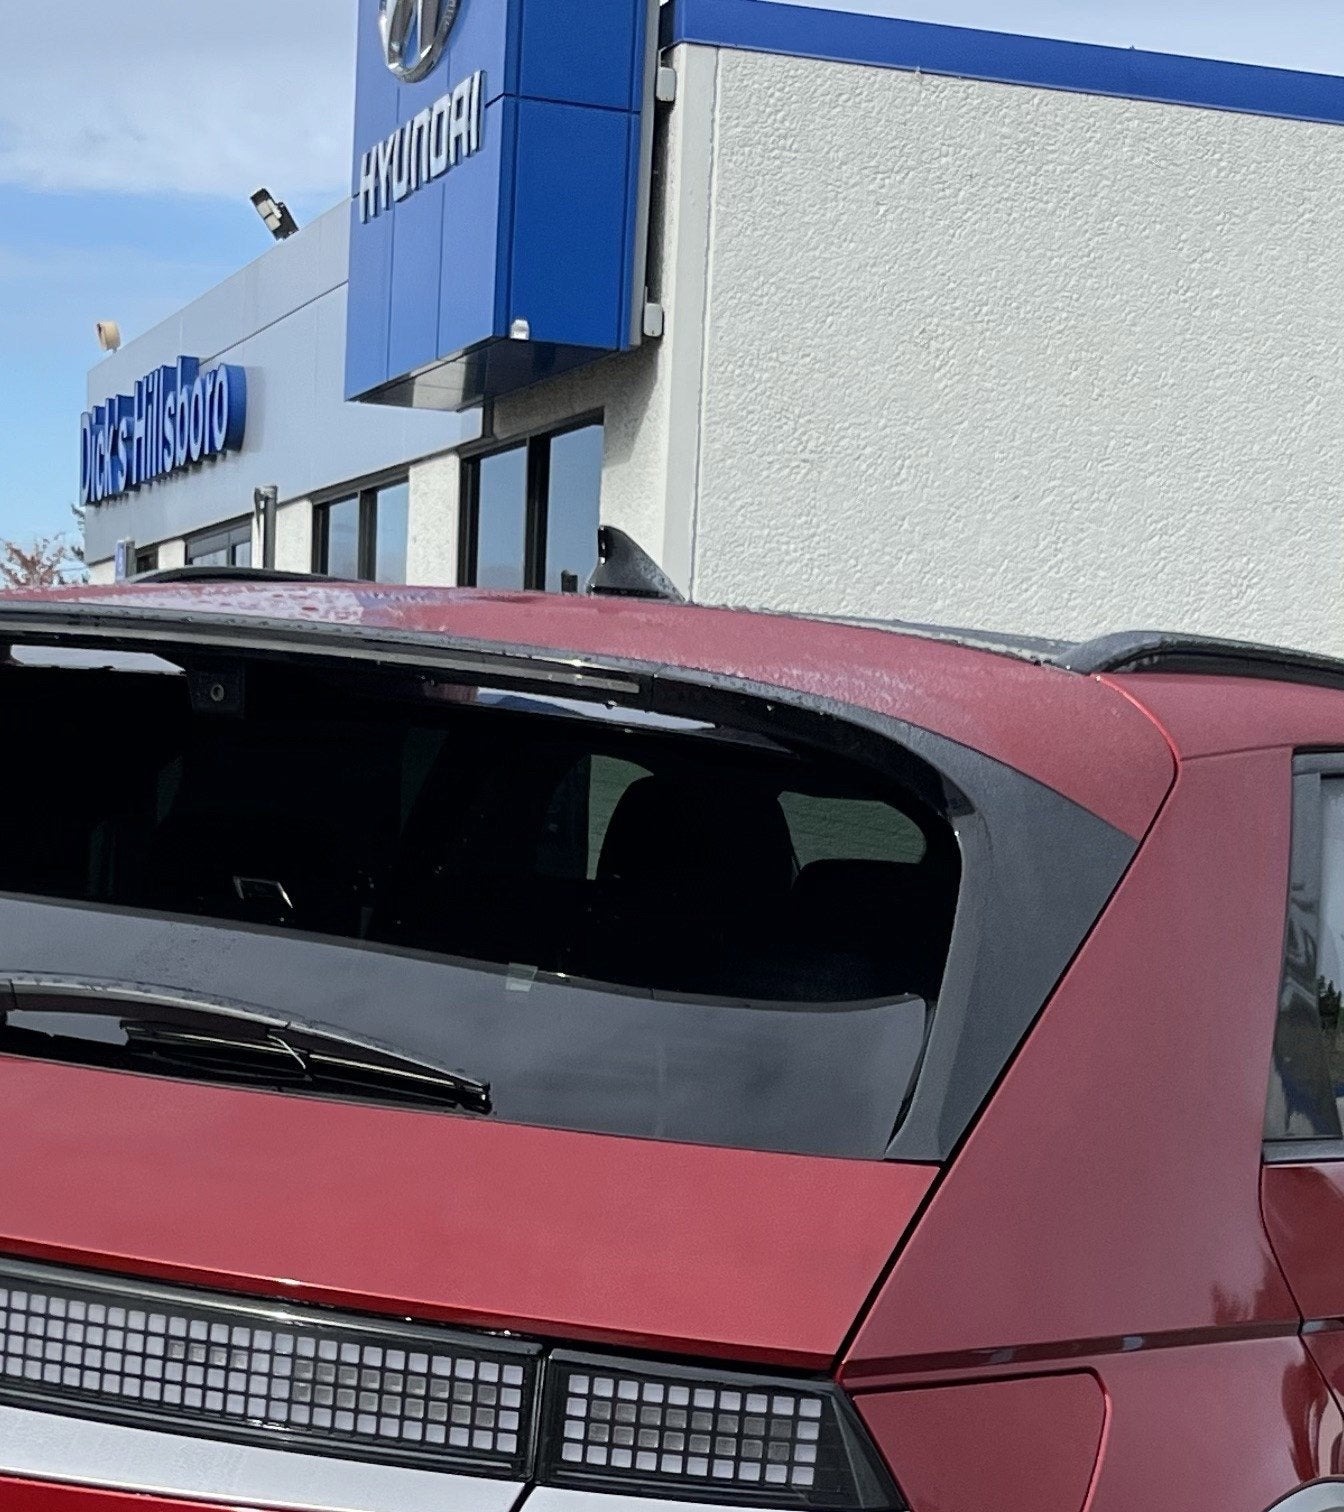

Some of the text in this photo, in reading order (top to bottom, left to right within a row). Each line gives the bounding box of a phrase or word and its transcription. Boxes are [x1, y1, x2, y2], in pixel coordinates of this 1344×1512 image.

[360, 70, 485, 223] HYUNDAI
[80, 356, 232, 505] Dick's Hillsboro
